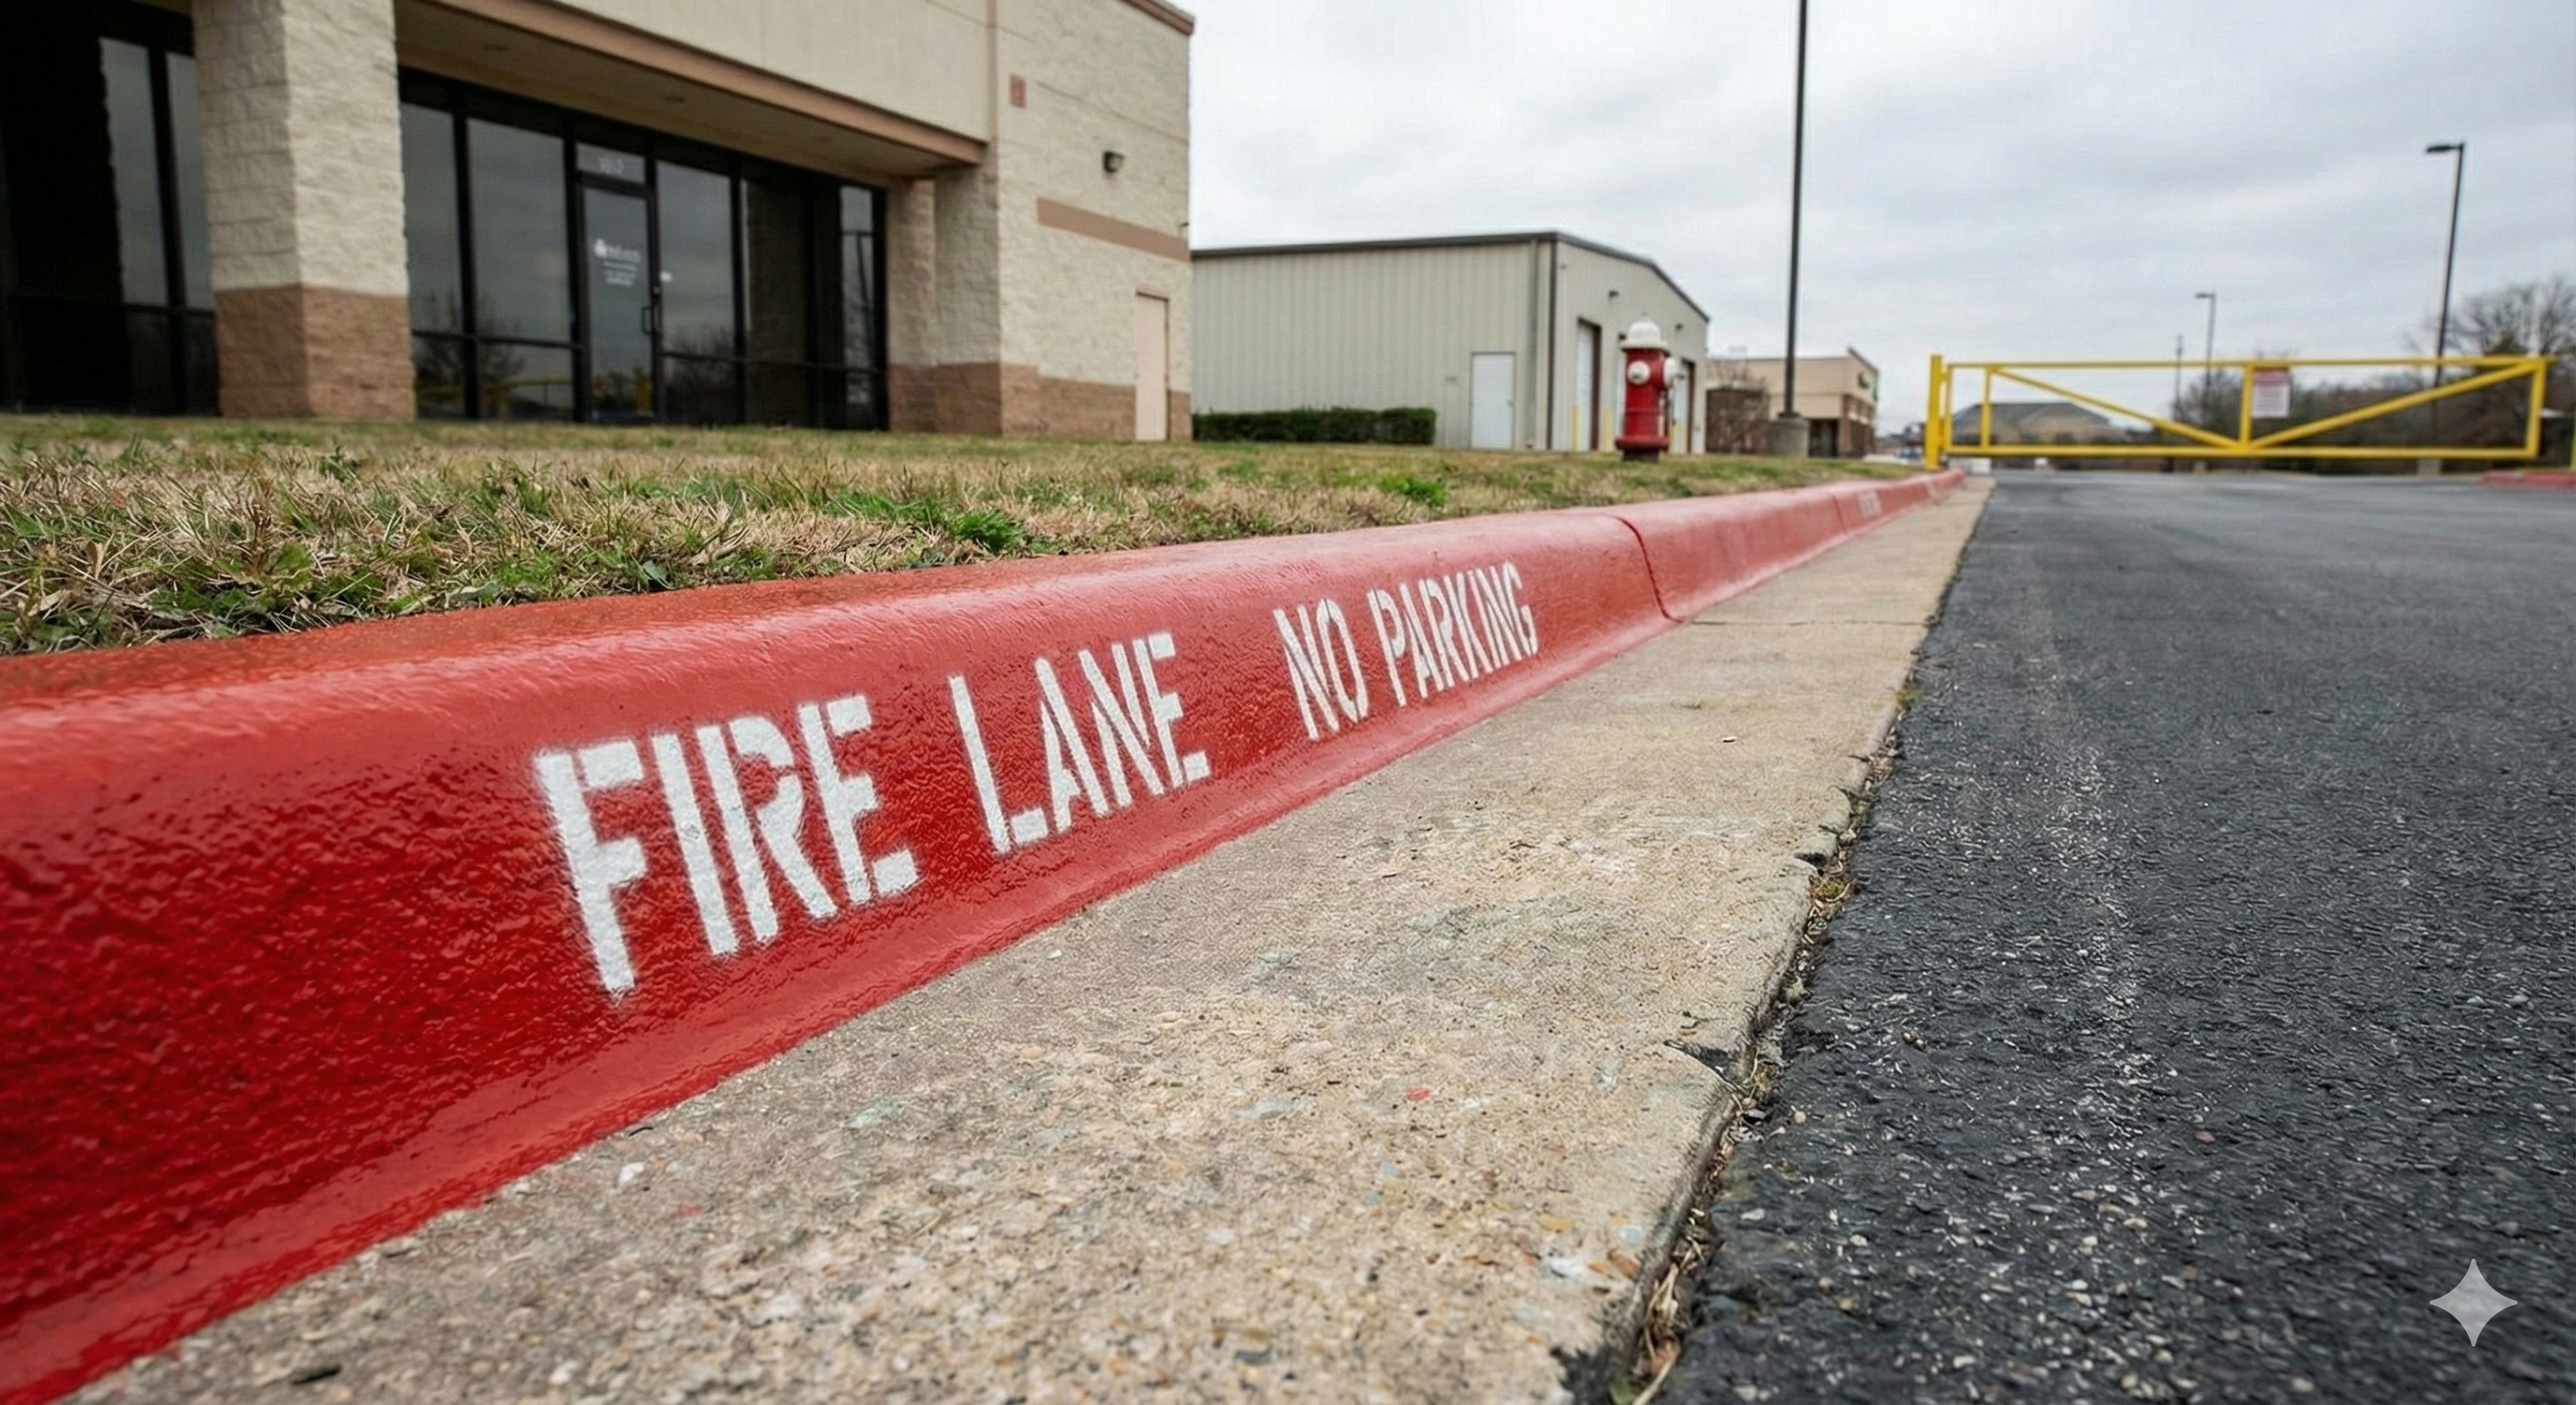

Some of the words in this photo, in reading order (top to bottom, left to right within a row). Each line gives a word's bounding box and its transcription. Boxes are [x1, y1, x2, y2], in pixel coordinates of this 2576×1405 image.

[533, 693, 919, 995] FIRE
[949, 630, 1209, 853] LANE
[1273, 598, 1368, 740] NO
[1368, 561, 1538, 706] PARKING
